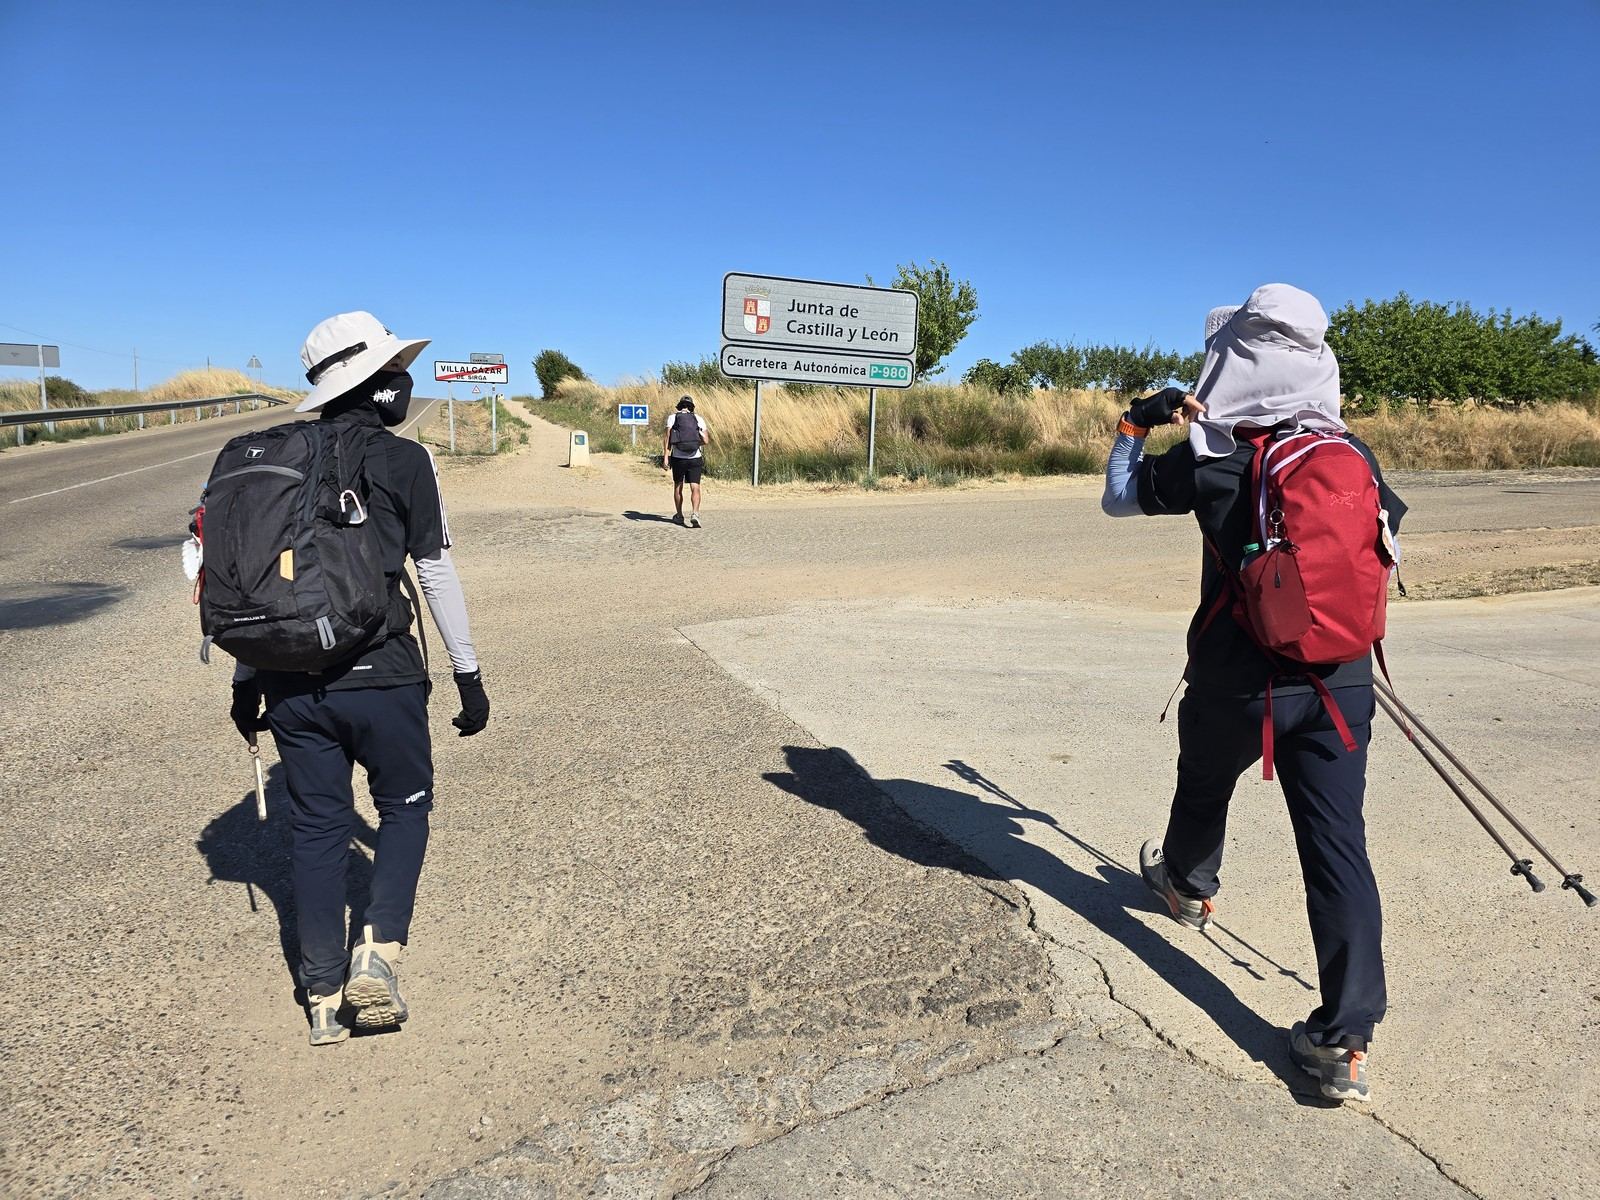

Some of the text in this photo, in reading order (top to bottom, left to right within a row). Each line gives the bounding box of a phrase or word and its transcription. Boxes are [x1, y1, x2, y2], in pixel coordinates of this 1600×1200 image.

[787, 299, 859, 318] Junta de
[786, 319, 899, 343] Castilla y León
[440, 365, 502, 375] VILLALCÁZAR
[727, 354, 907, 379] Carretera Autonómica P-980
